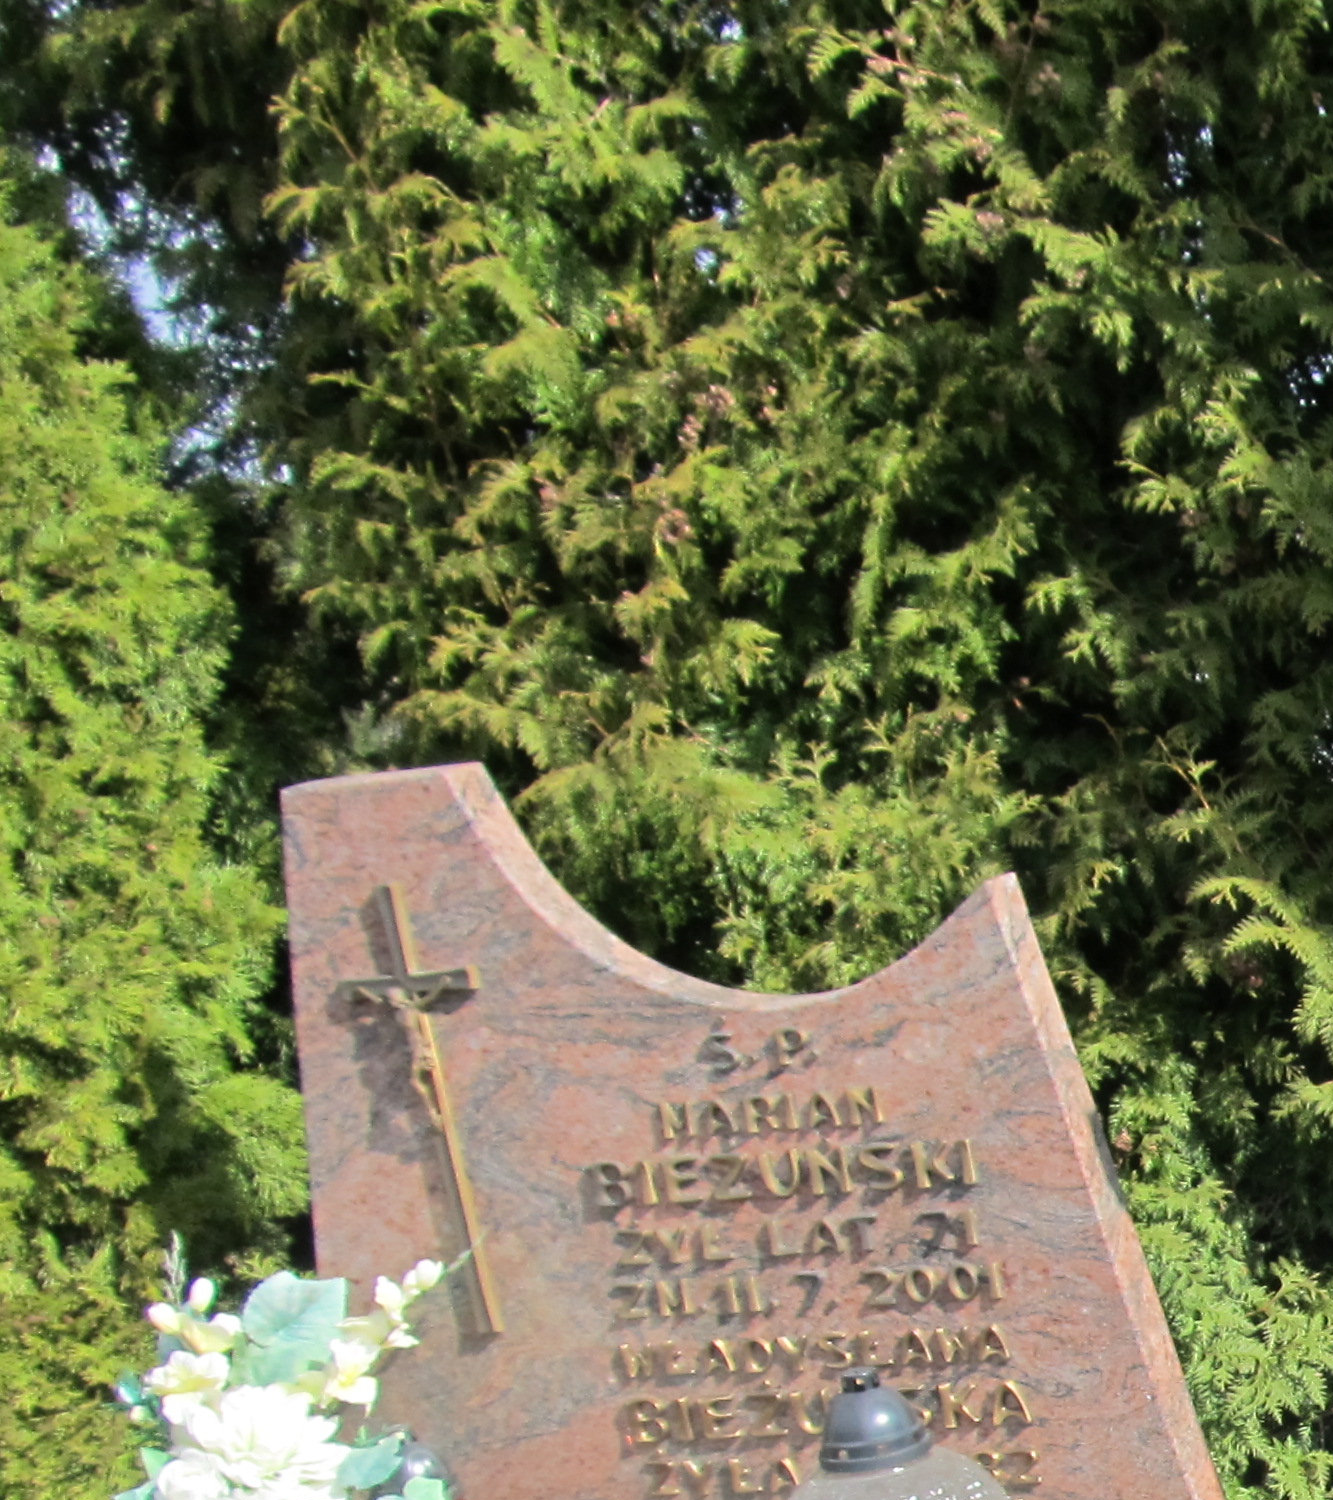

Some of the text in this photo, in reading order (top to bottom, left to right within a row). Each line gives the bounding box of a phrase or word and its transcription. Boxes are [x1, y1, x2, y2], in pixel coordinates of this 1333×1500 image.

[656, 1086, 885, 1140] MARIAN
[762, 1212, 877, 1256] LAT
[913, 1208, 980, 1254] 71
[856, 1260, 1003, 1306] 2001
